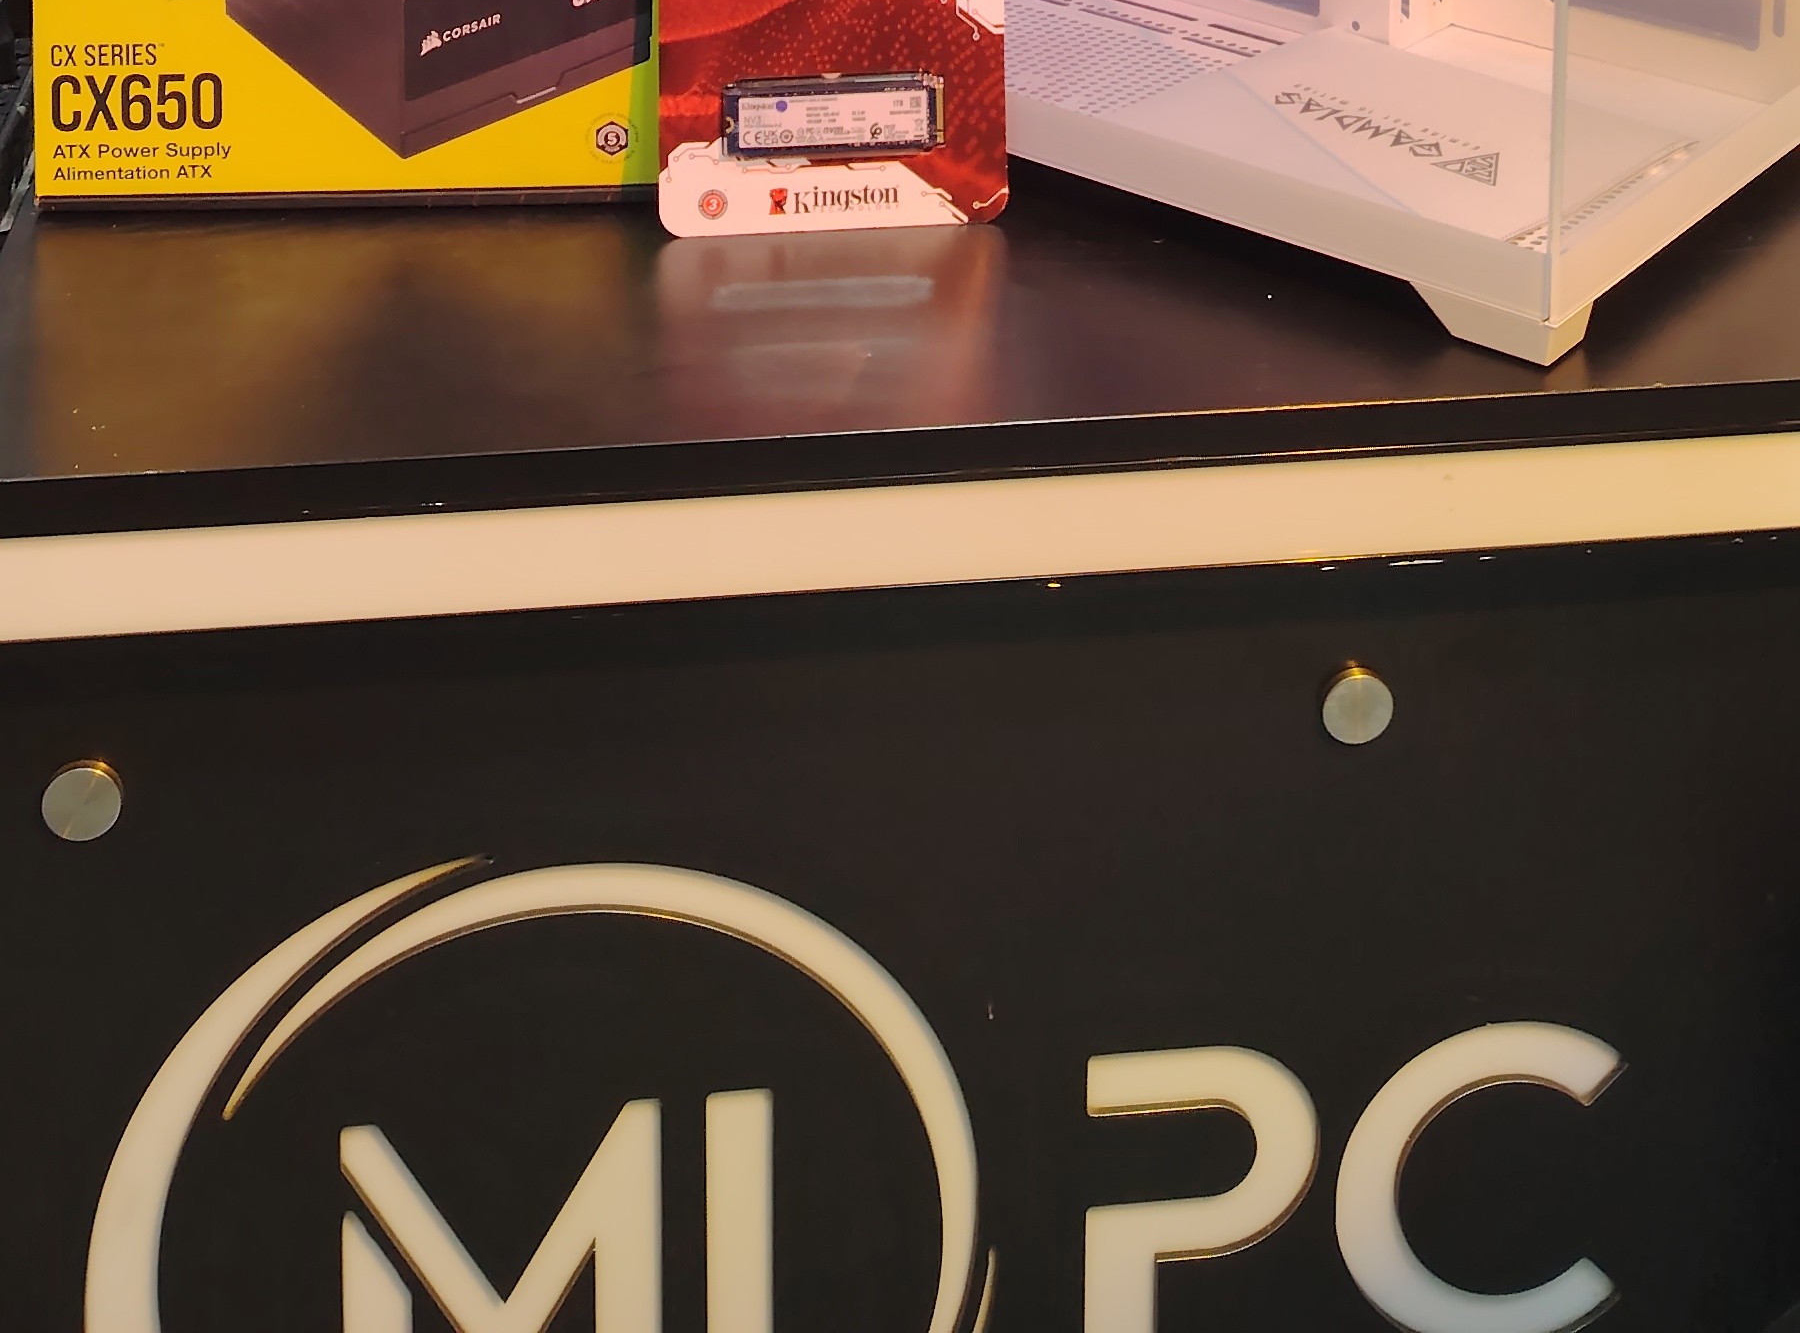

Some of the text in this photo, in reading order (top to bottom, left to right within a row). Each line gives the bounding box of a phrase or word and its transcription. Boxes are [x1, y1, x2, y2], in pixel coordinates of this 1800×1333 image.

[443, 13, 501, 42] CORSAIR
[51, 43, 158, 67] CX SERIES
[51, 73, 222, 132] CX650
[53, 142, 232, 161] ATX Power Supply
[53, 164, 213, 181] Alimentation ATX
[793, 185, 899, 213] Kingston
[1085, 1020, 1628, 1333] PC
